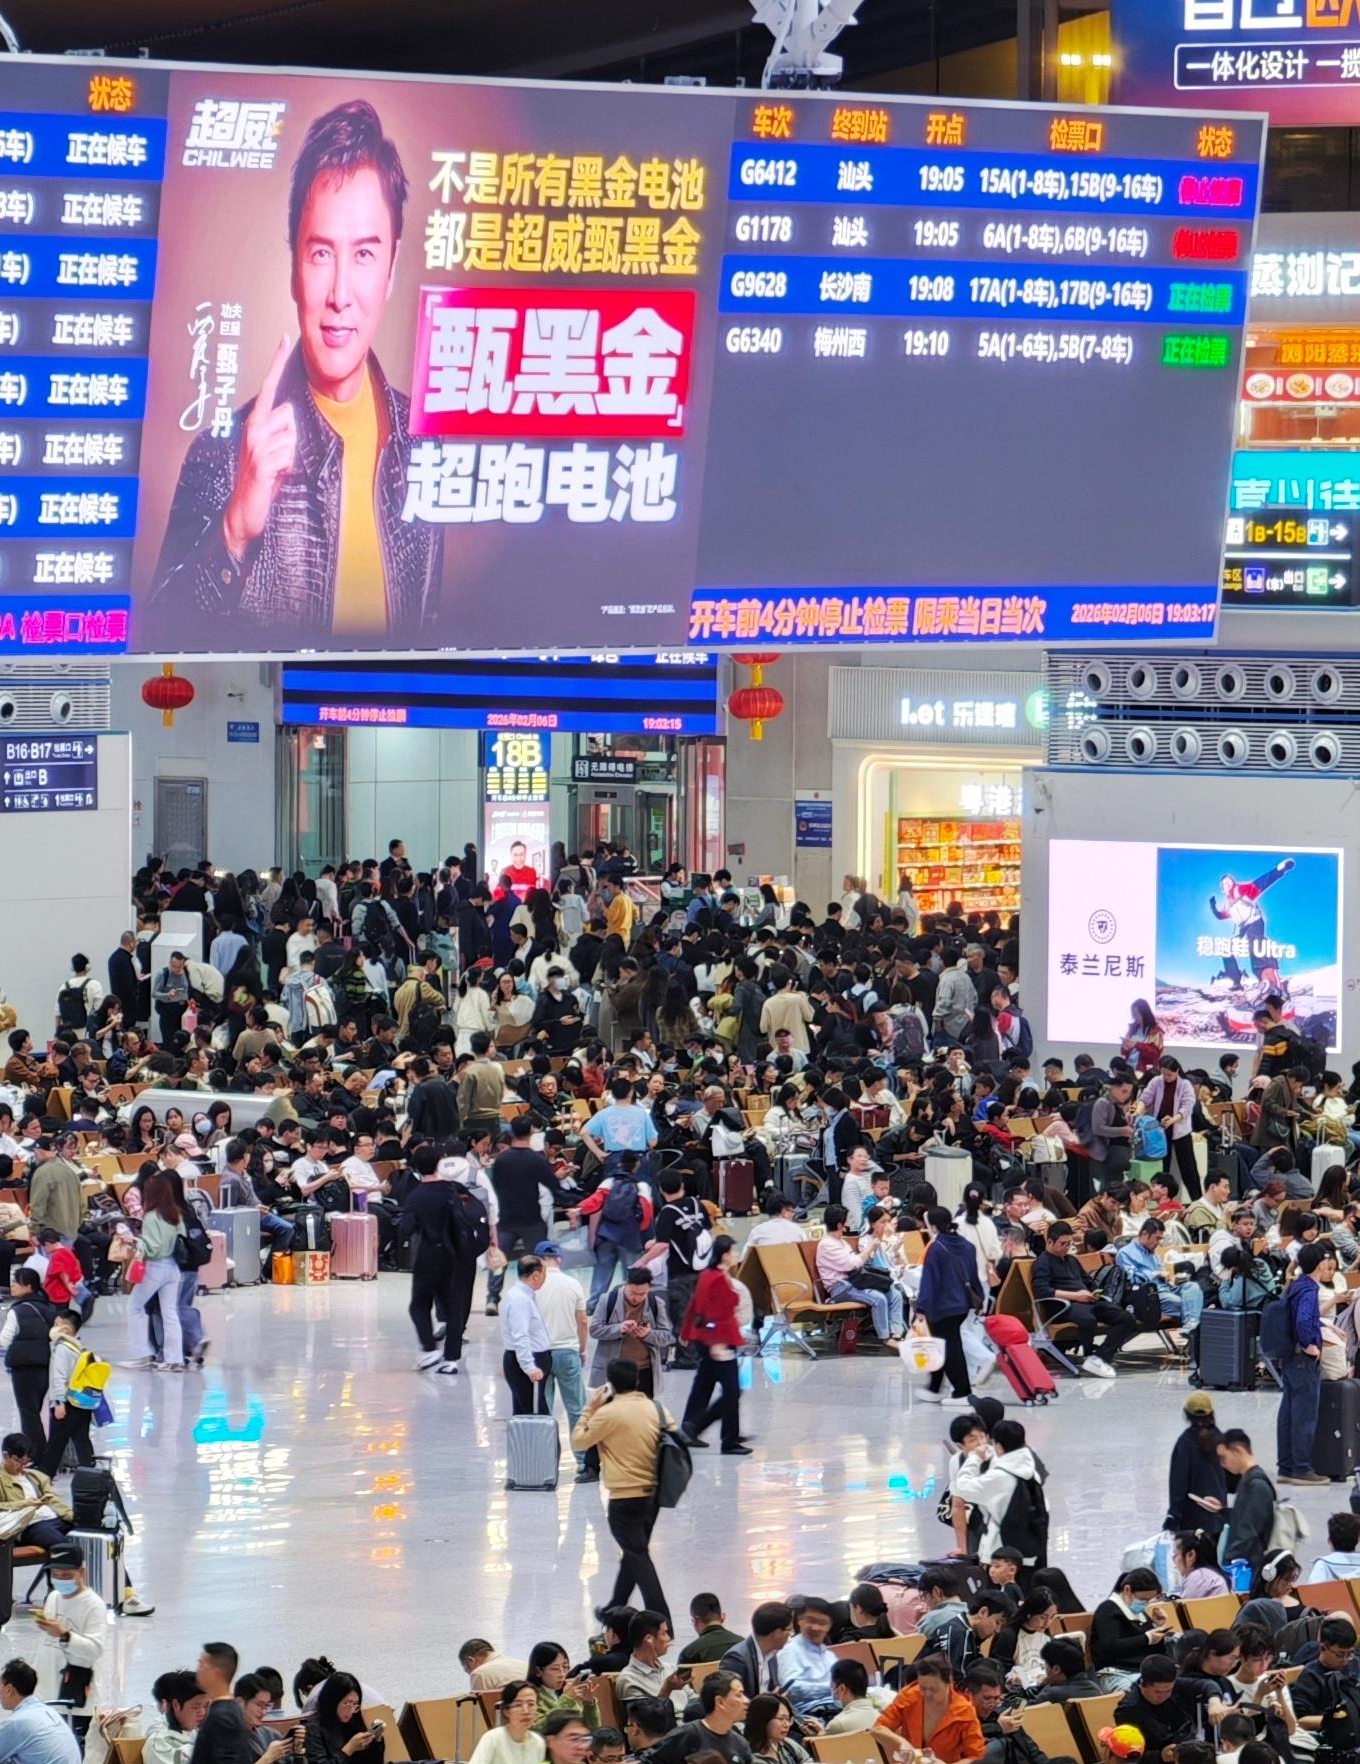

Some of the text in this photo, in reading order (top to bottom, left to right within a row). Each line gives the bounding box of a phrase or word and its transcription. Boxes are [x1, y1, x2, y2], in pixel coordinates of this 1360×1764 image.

[1186, 50, 1308, 81] 一体化设计
[89, 75, 133, 111] 状态
[185, 100, 286, 150] 超威
[753, 106, 1233, 157] 车次 终到站 开点 检票口 状态
[66, 132, 148, 166] 正在候车
[182, 151, 274, 168] CHILWEE
[428, 151, 704, 210] 不是所有黑金电池
[741, 160, 797, 187] G6412
[837, 161, 873, 191] 汕头
[919, 166, 964, 192] 19:05
[62, 192, 142, 226] 正在候车
[424, 213, 701, 275] 都是超威甄黑金
[731, 272, 787, 298] G9628
[819, 273, 872, 302] 长沙南
[909, 276, 954, 301] 19:08
[1168, 284, 1232, 314] 正在检票
[726, 327, 782, 354] G6340
[814, 327, 866, 357] 梅州西
[903, 330, 949, 356] 19:10
[1163, 336, 1228, 366] 正在检票
[401, 441, 678, 524] 超跑电池
[33, 553, 114, 584] 正在候车
[689, 598, 909, 638] 开车前4分钟停止检票
[492, 740, 541, 767] 18B
[1196, 935, 1297, 960] 稳跑鞋 Ultra
[1060, 952, 1146, 979] 泰兰尼斯
